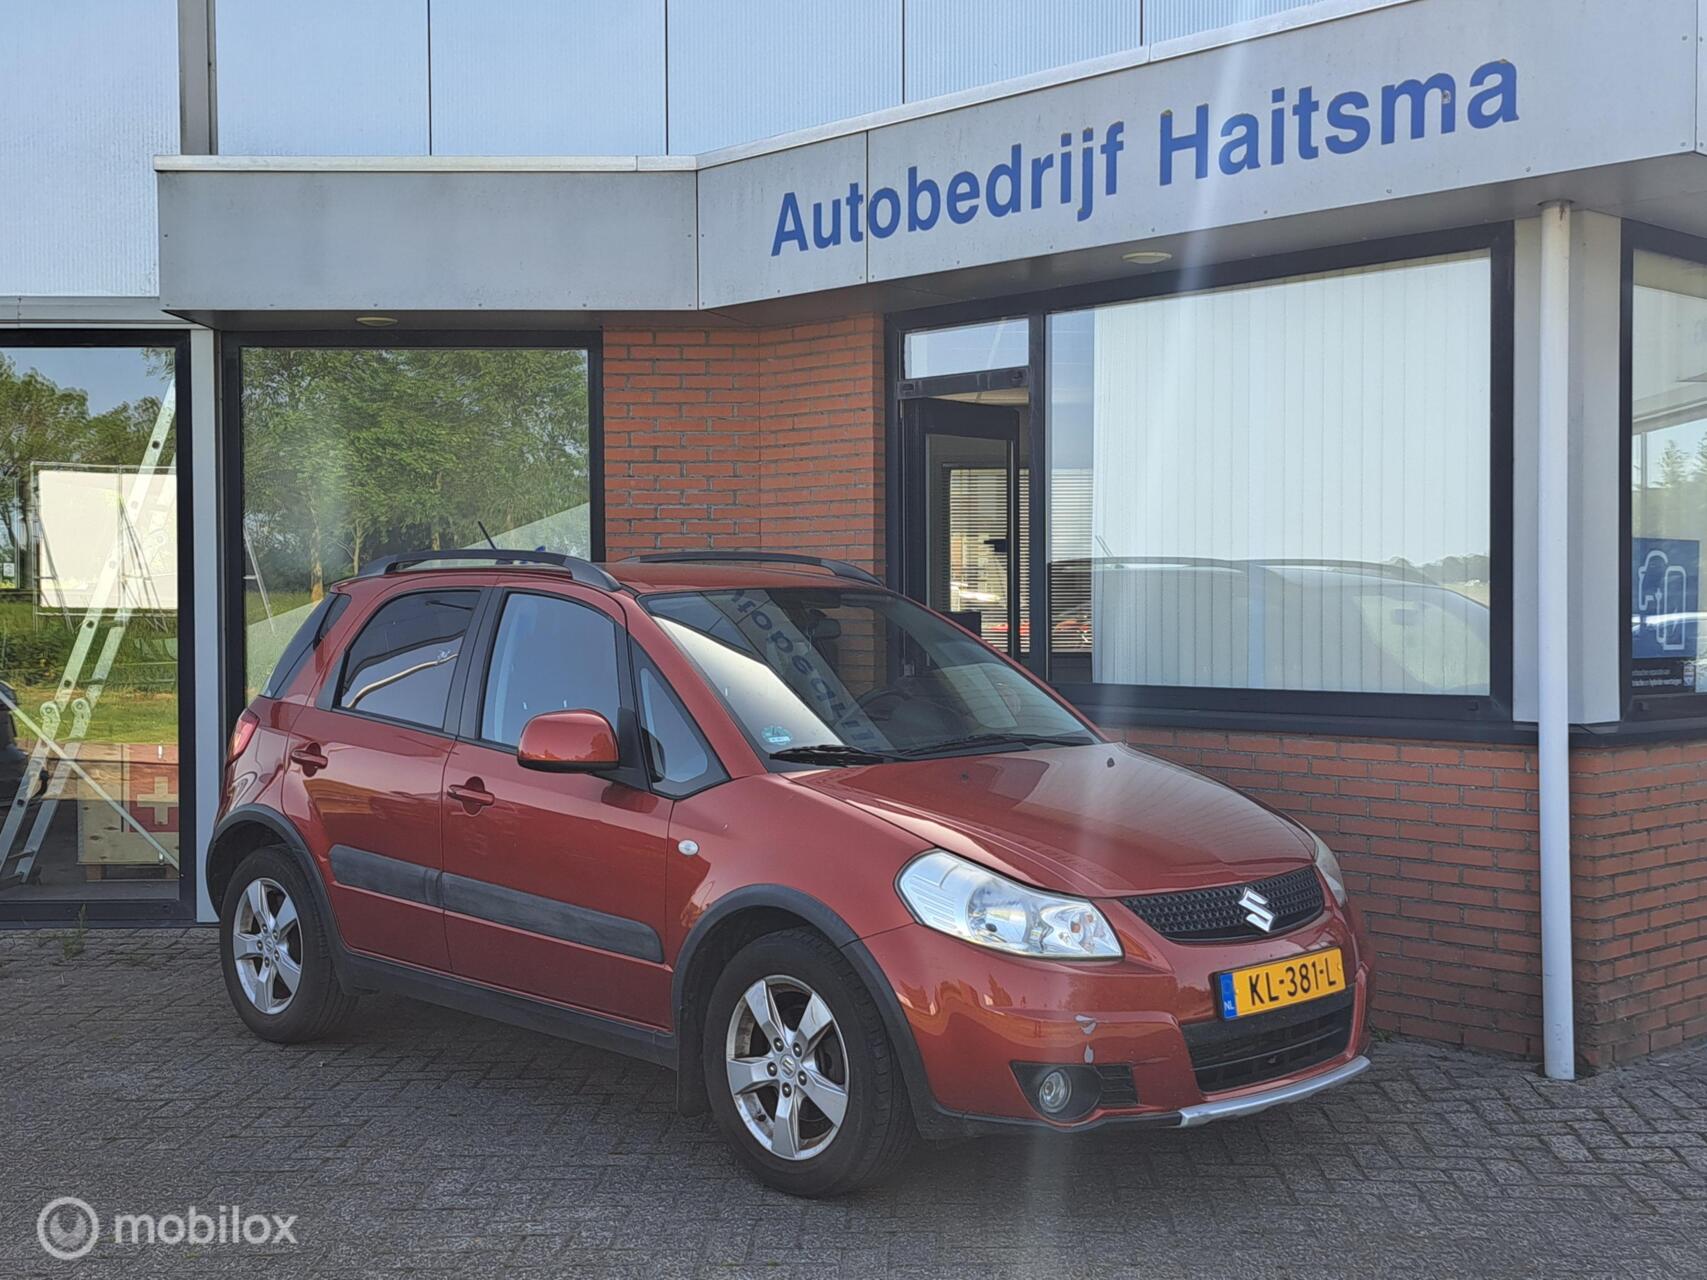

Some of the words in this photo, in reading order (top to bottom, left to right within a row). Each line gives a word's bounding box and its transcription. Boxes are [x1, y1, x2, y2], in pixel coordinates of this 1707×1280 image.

[771, 120, 1125, 257] Autobedrijf
[1159, 58, 1520, 187] Haitsma
[1223, 1000, 1235, 1011] NL
[1248, 957, 1337, 1007] KL-381-L
